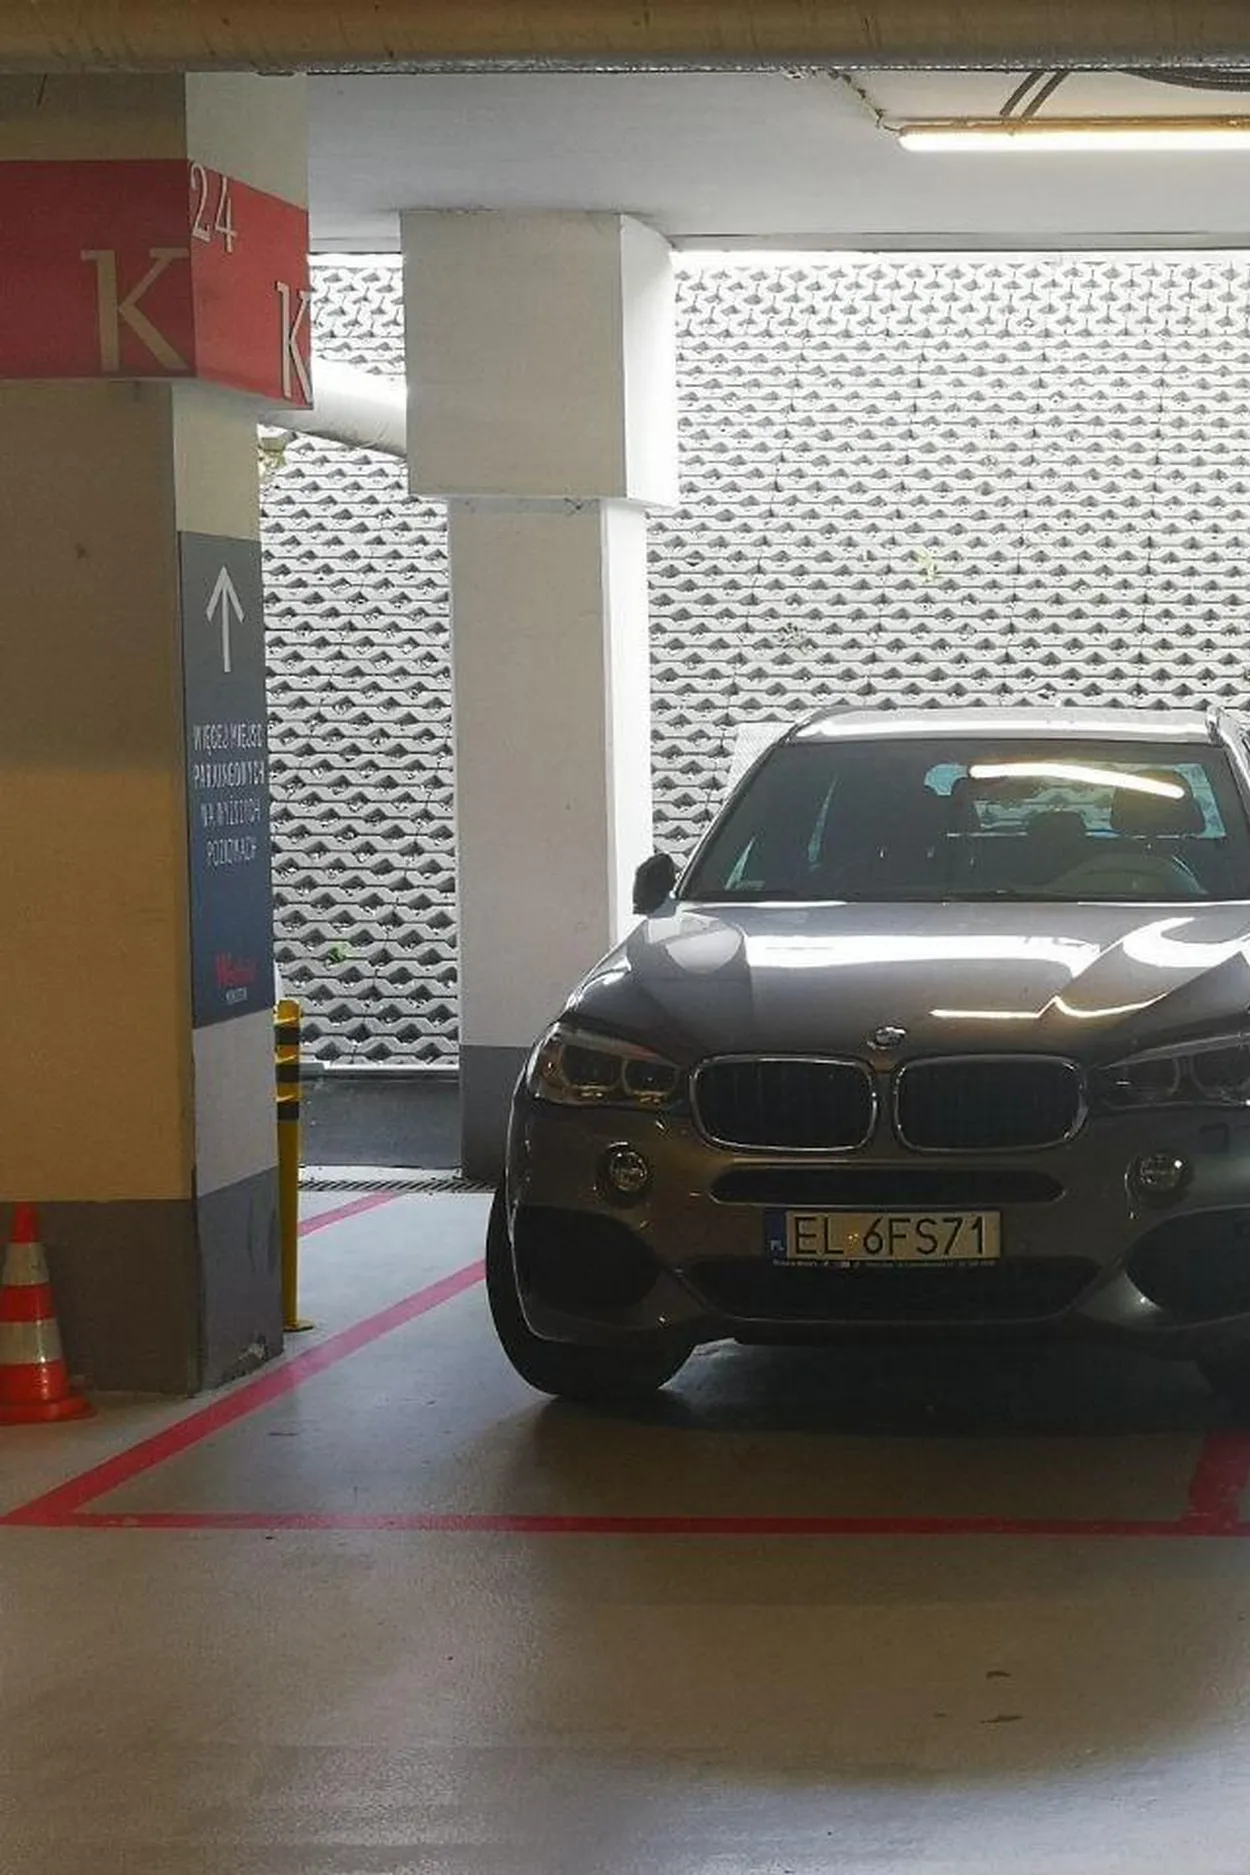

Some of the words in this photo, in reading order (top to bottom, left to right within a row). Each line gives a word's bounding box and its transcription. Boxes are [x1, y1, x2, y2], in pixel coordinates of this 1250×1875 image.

[191, 162, 237, 253] 24
[81, 248, 190, 371] K
[275, 281, 312, 404] K
[794, 1216, 844, 1255] EL
[863, 1216, 985, 1256] 6FS71
